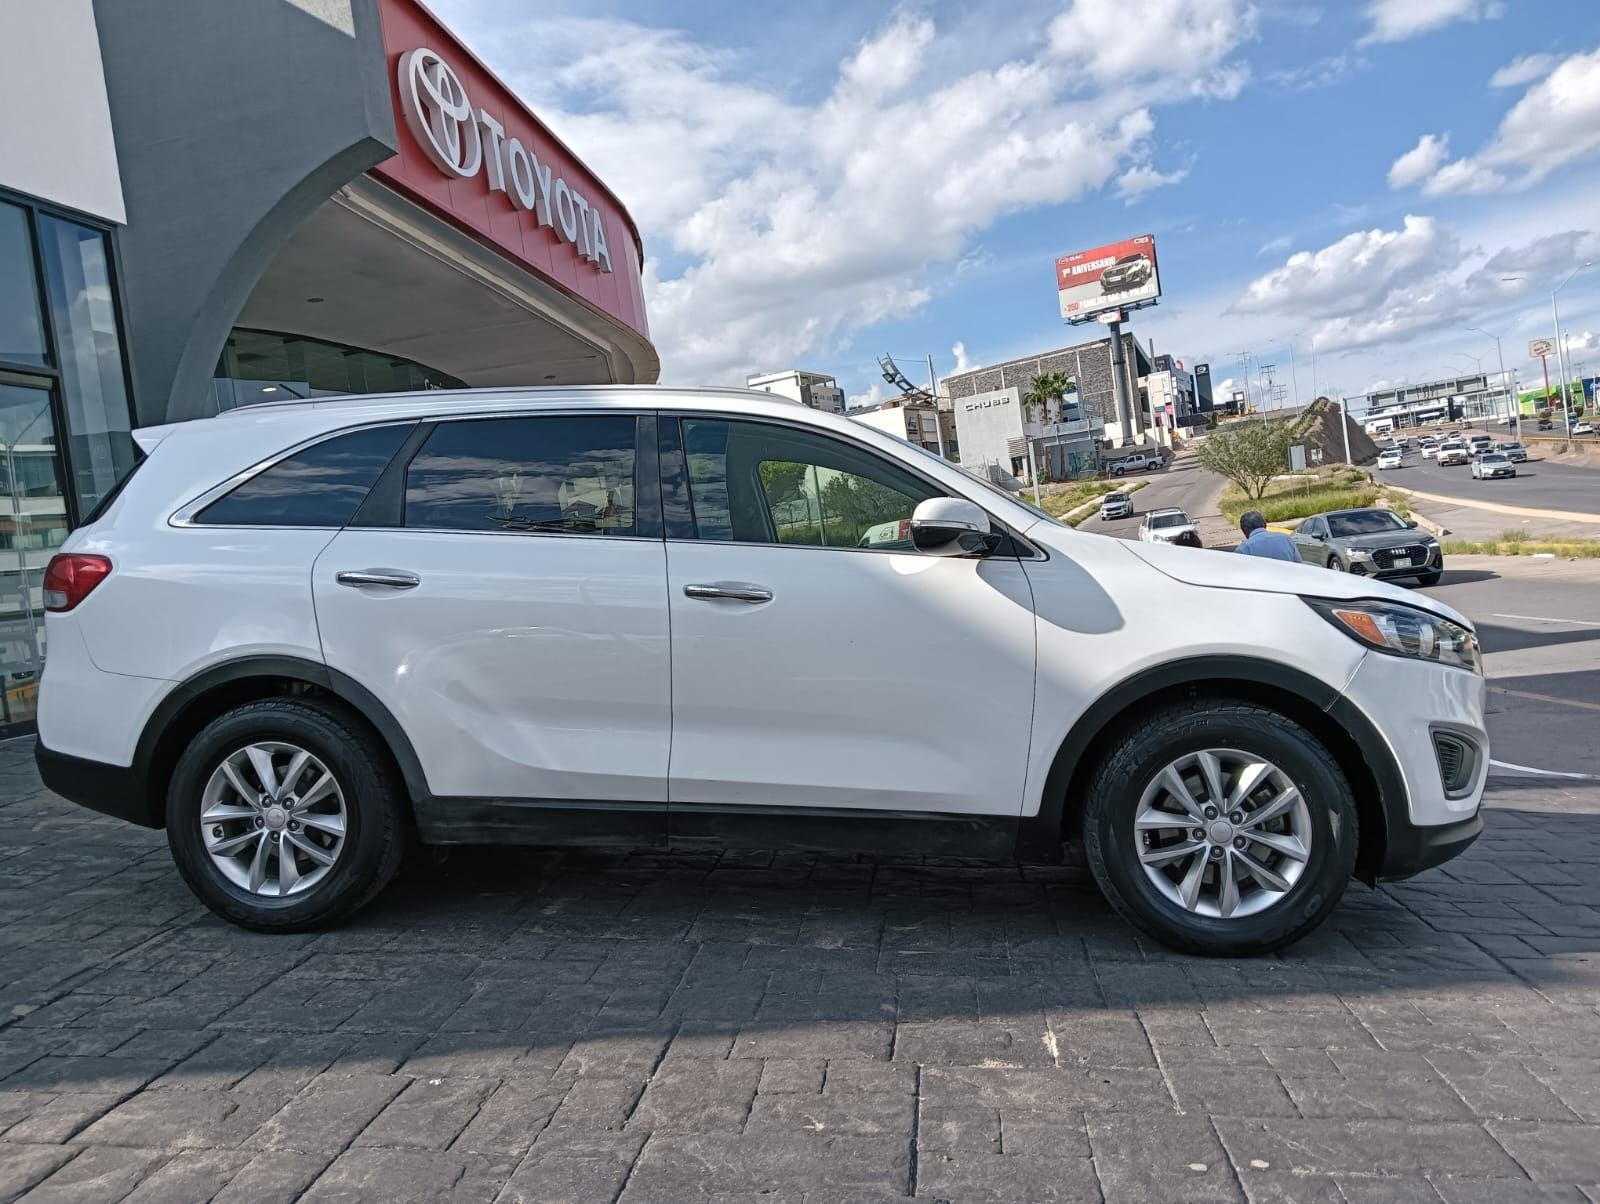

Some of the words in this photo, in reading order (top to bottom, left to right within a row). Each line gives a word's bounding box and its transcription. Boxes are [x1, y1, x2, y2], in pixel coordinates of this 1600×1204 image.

[476, 109, 612, 273] TOYOTA
[1072, 256, 1116, 275] ANIVERSARIO
[965, 397, 1010, 411] CHUBB
